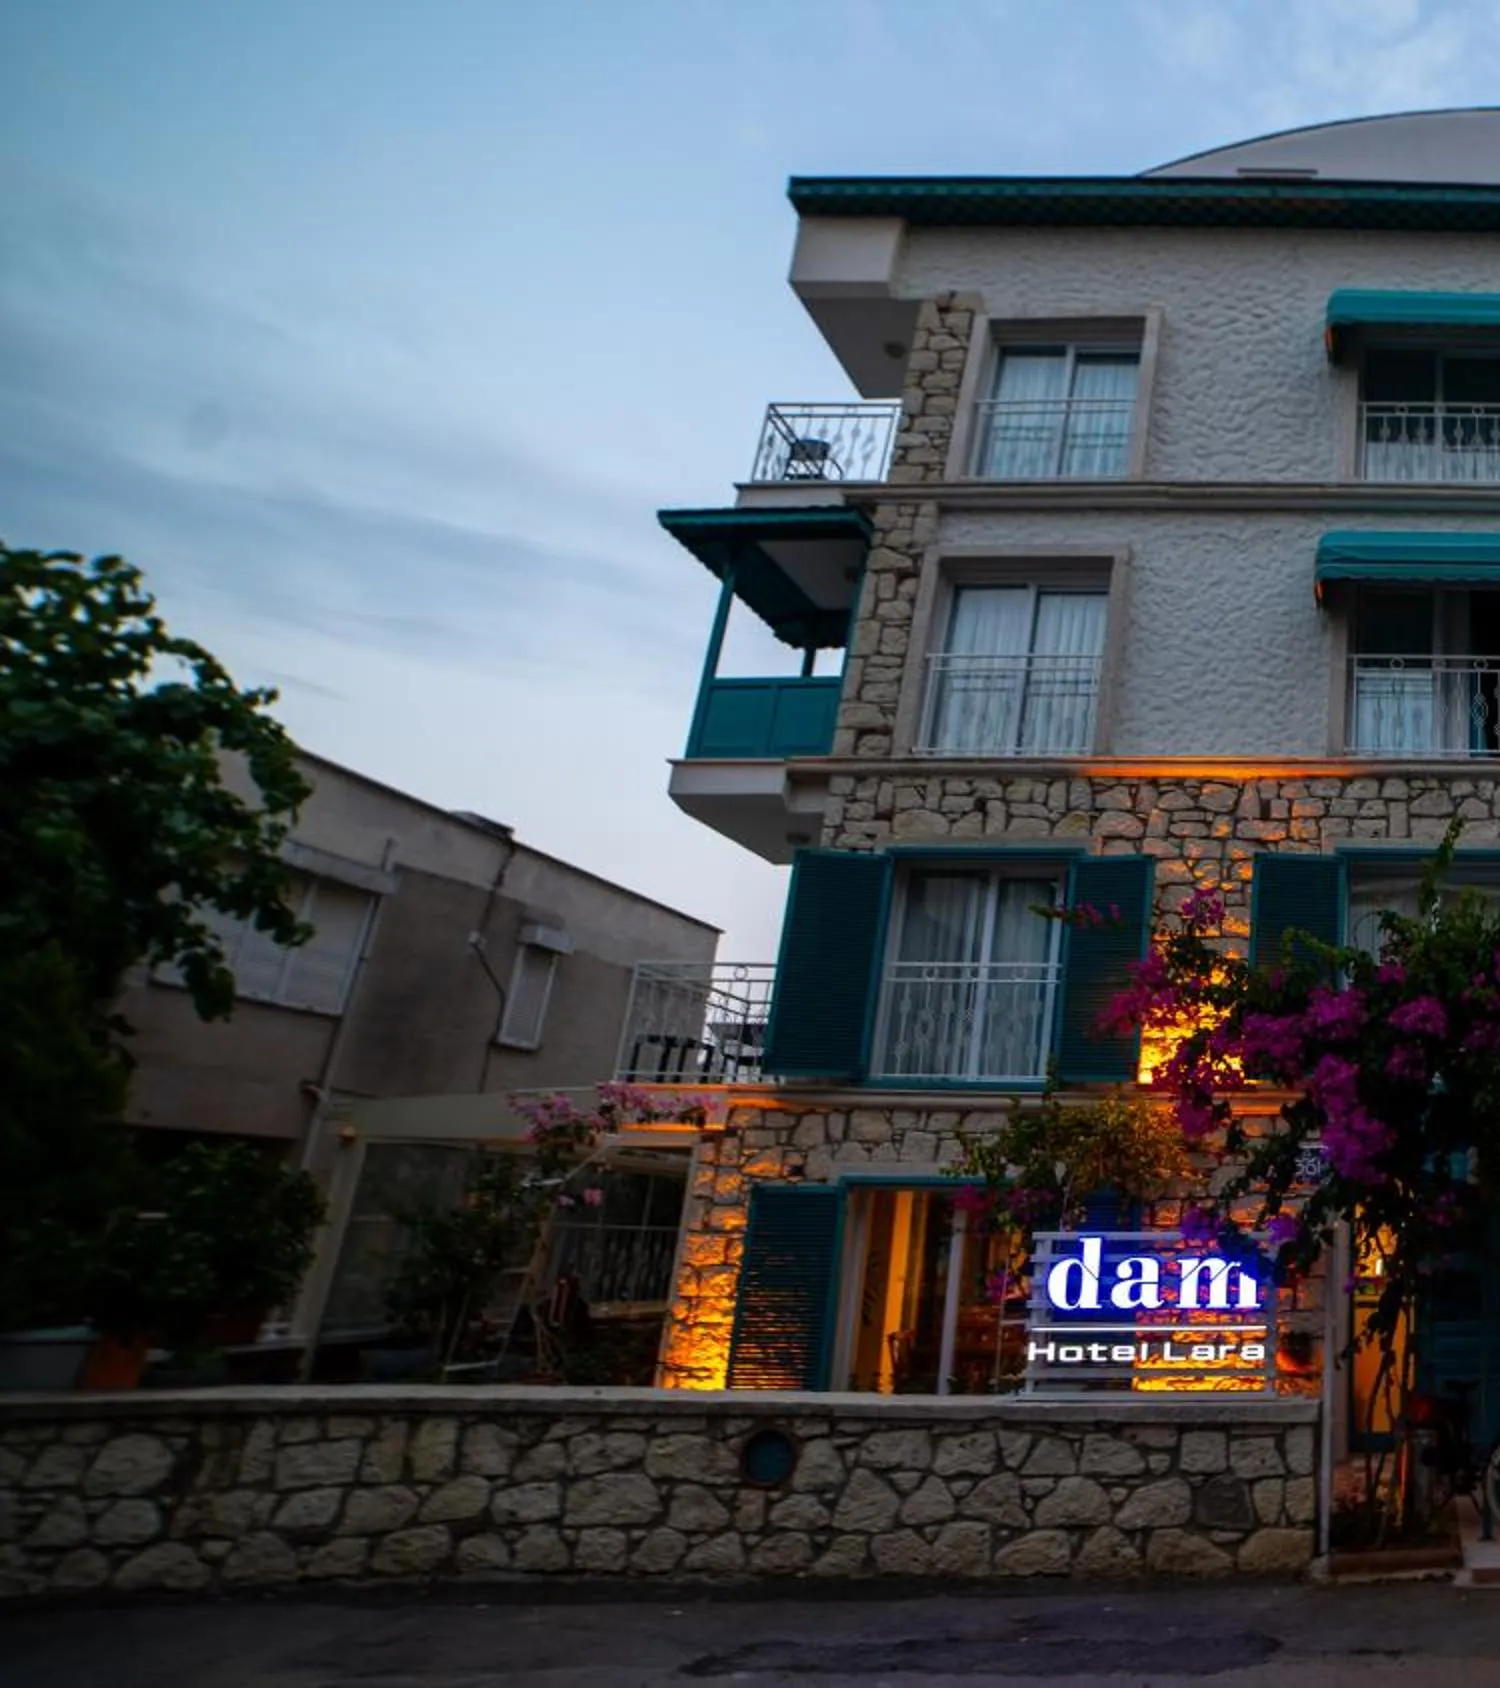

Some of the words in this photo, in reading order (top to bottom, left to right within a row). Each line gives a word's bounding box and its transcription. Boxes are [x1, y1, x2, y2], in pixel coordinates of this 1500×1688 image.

[1047, 1237, 1261, 1310] dam
[1027, 1342, 1149, 1362] Hotel
[1164, 1342, 1266, 1362] Lara
